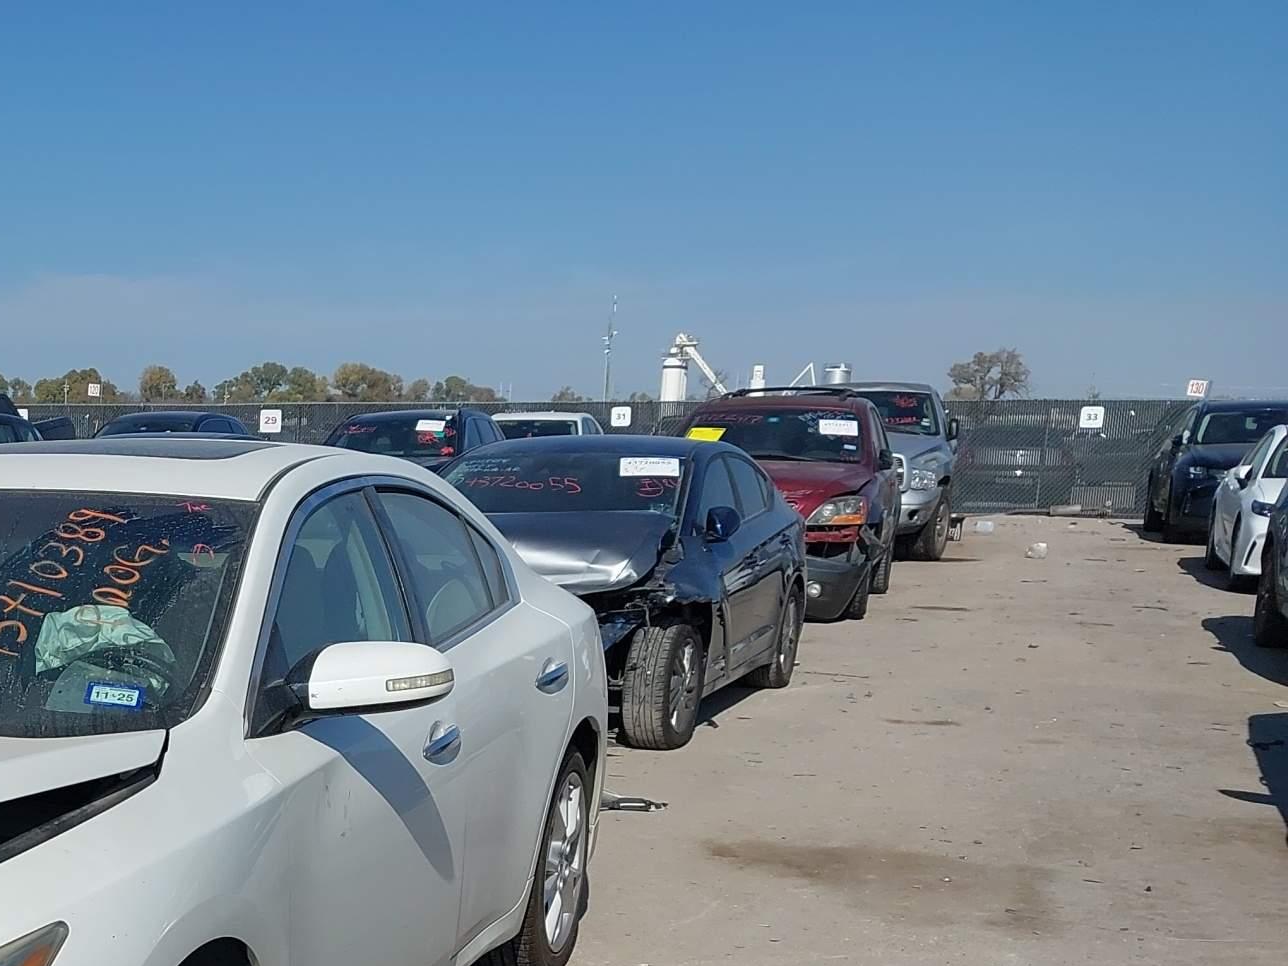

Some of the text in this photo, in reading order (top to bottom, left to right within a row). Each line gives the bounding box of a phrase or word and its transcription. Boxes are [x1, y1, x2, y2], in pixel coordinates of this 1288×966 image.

[1190, 382, 1205, 394] 130
[615, 412, 626, 420] 31
[1086, 413, 1098, 421] 33
[264, 416, 277, 425] 29
